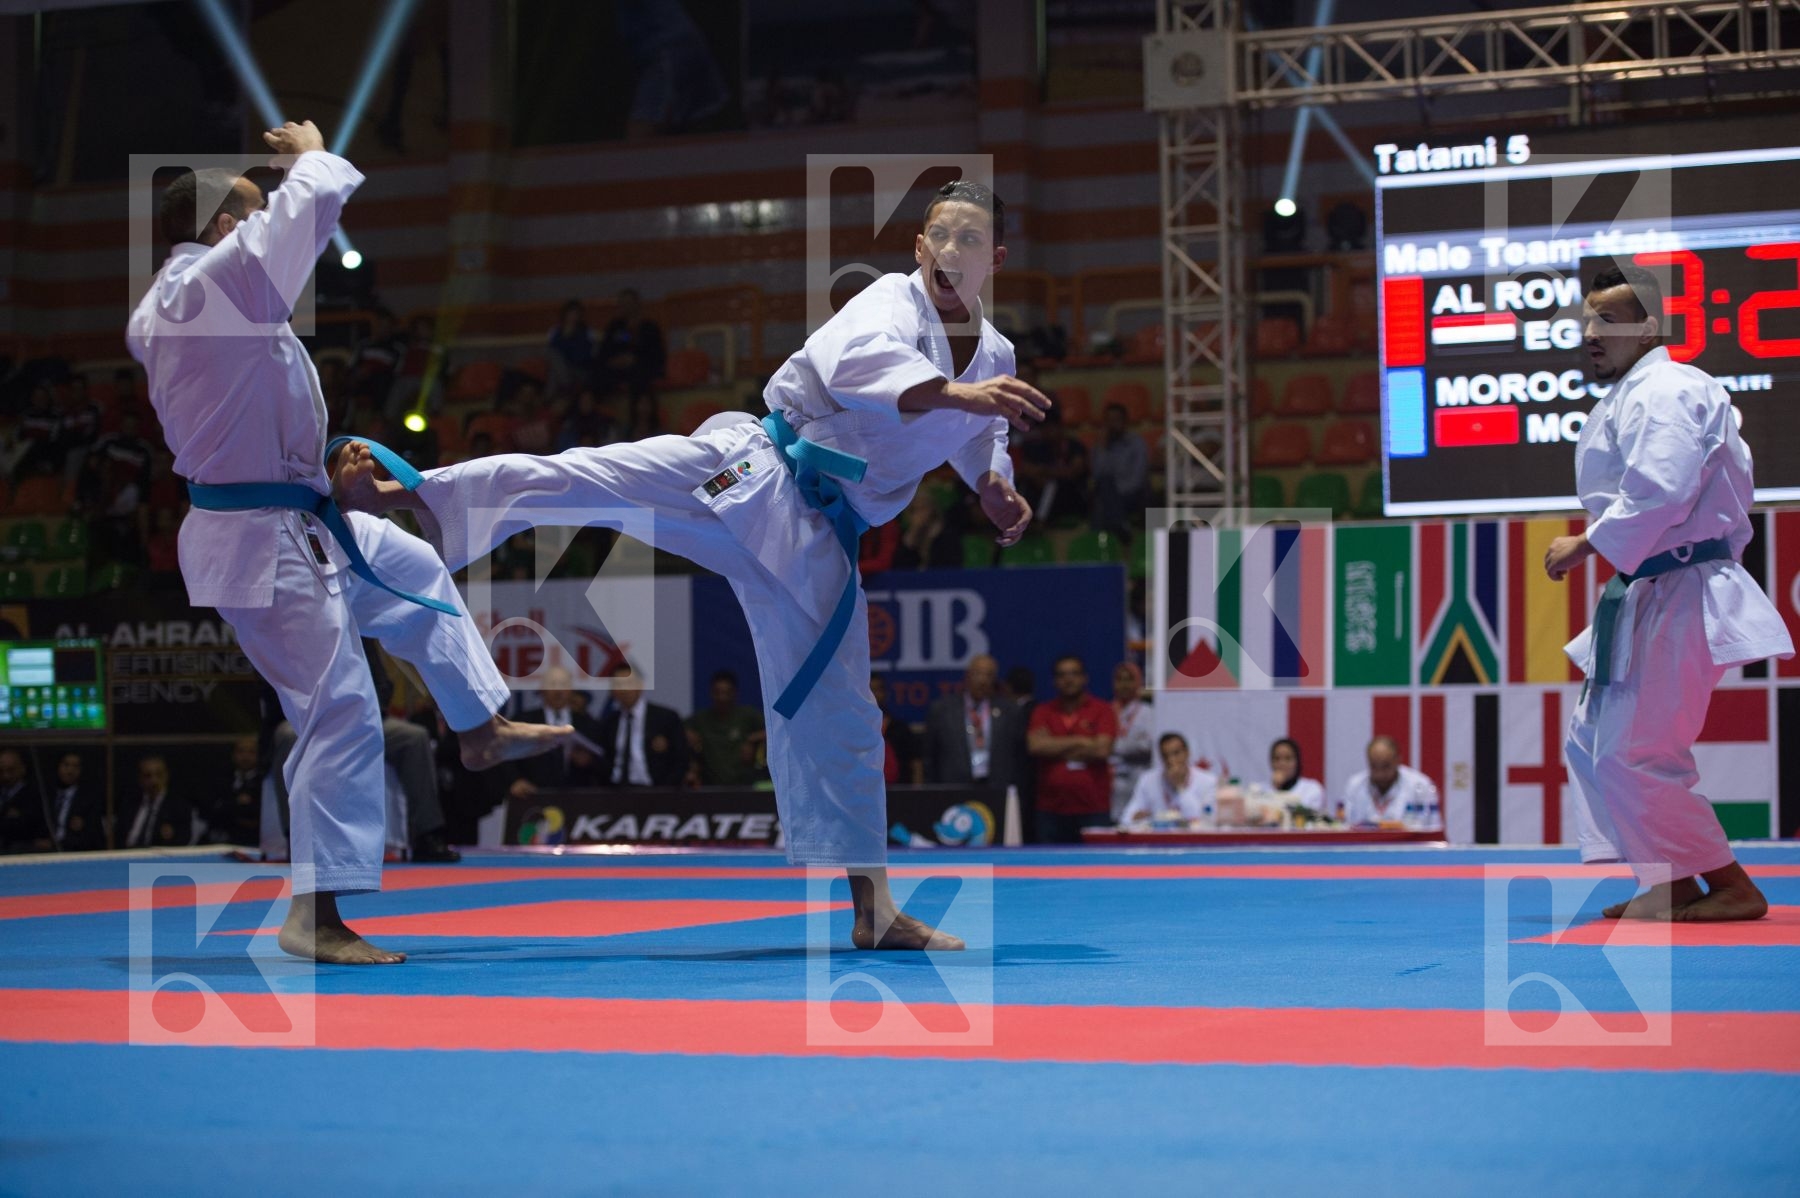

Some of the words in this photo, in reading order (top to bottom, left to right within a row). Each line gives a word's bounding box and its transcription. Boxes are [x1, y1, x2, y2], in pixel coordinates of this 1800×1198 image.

[1373, 135, 1498, 174] Tatami
[1506, 133, 1531, 165] 5
[1383, 240, 1472, 274] Male
[1431, 283, 1487, 315] AL
[1493, 276, 1582, 311] ROW
[1523, 318, 1583, 351] EG
[1434, 369, 1613, 407] MOROC
[112, 651, 252, 675] ERTISING
[112, 679, 218, 703] GENCY
